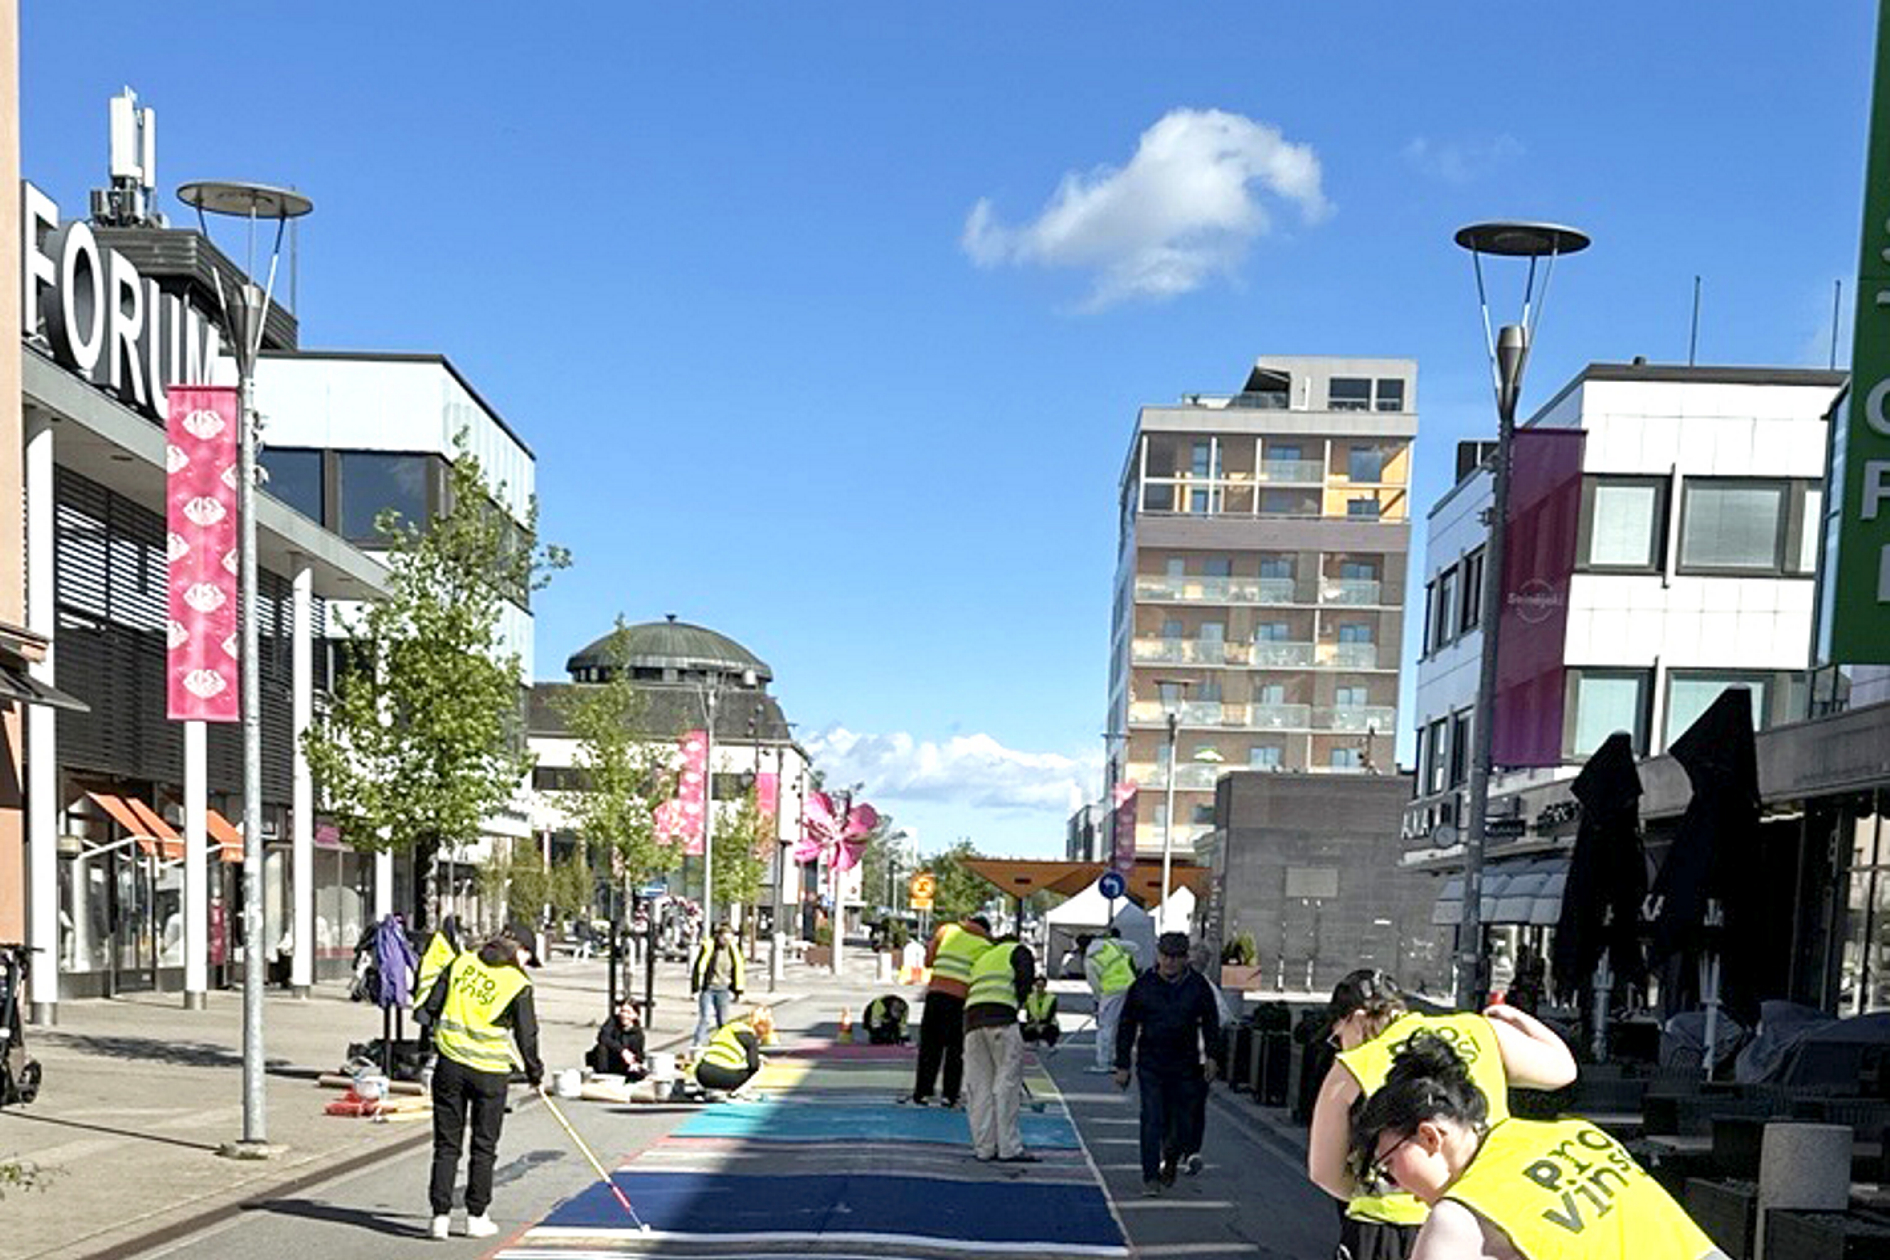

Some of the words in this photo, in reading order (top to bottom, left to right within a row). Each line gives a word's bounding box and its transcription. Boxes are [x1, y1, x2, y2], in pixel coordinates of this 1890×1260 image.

[25, 180, 219, 420] FORUM
[462, 965, 496, 991] pro
[1522, 1129, 1614, 1193] pro
